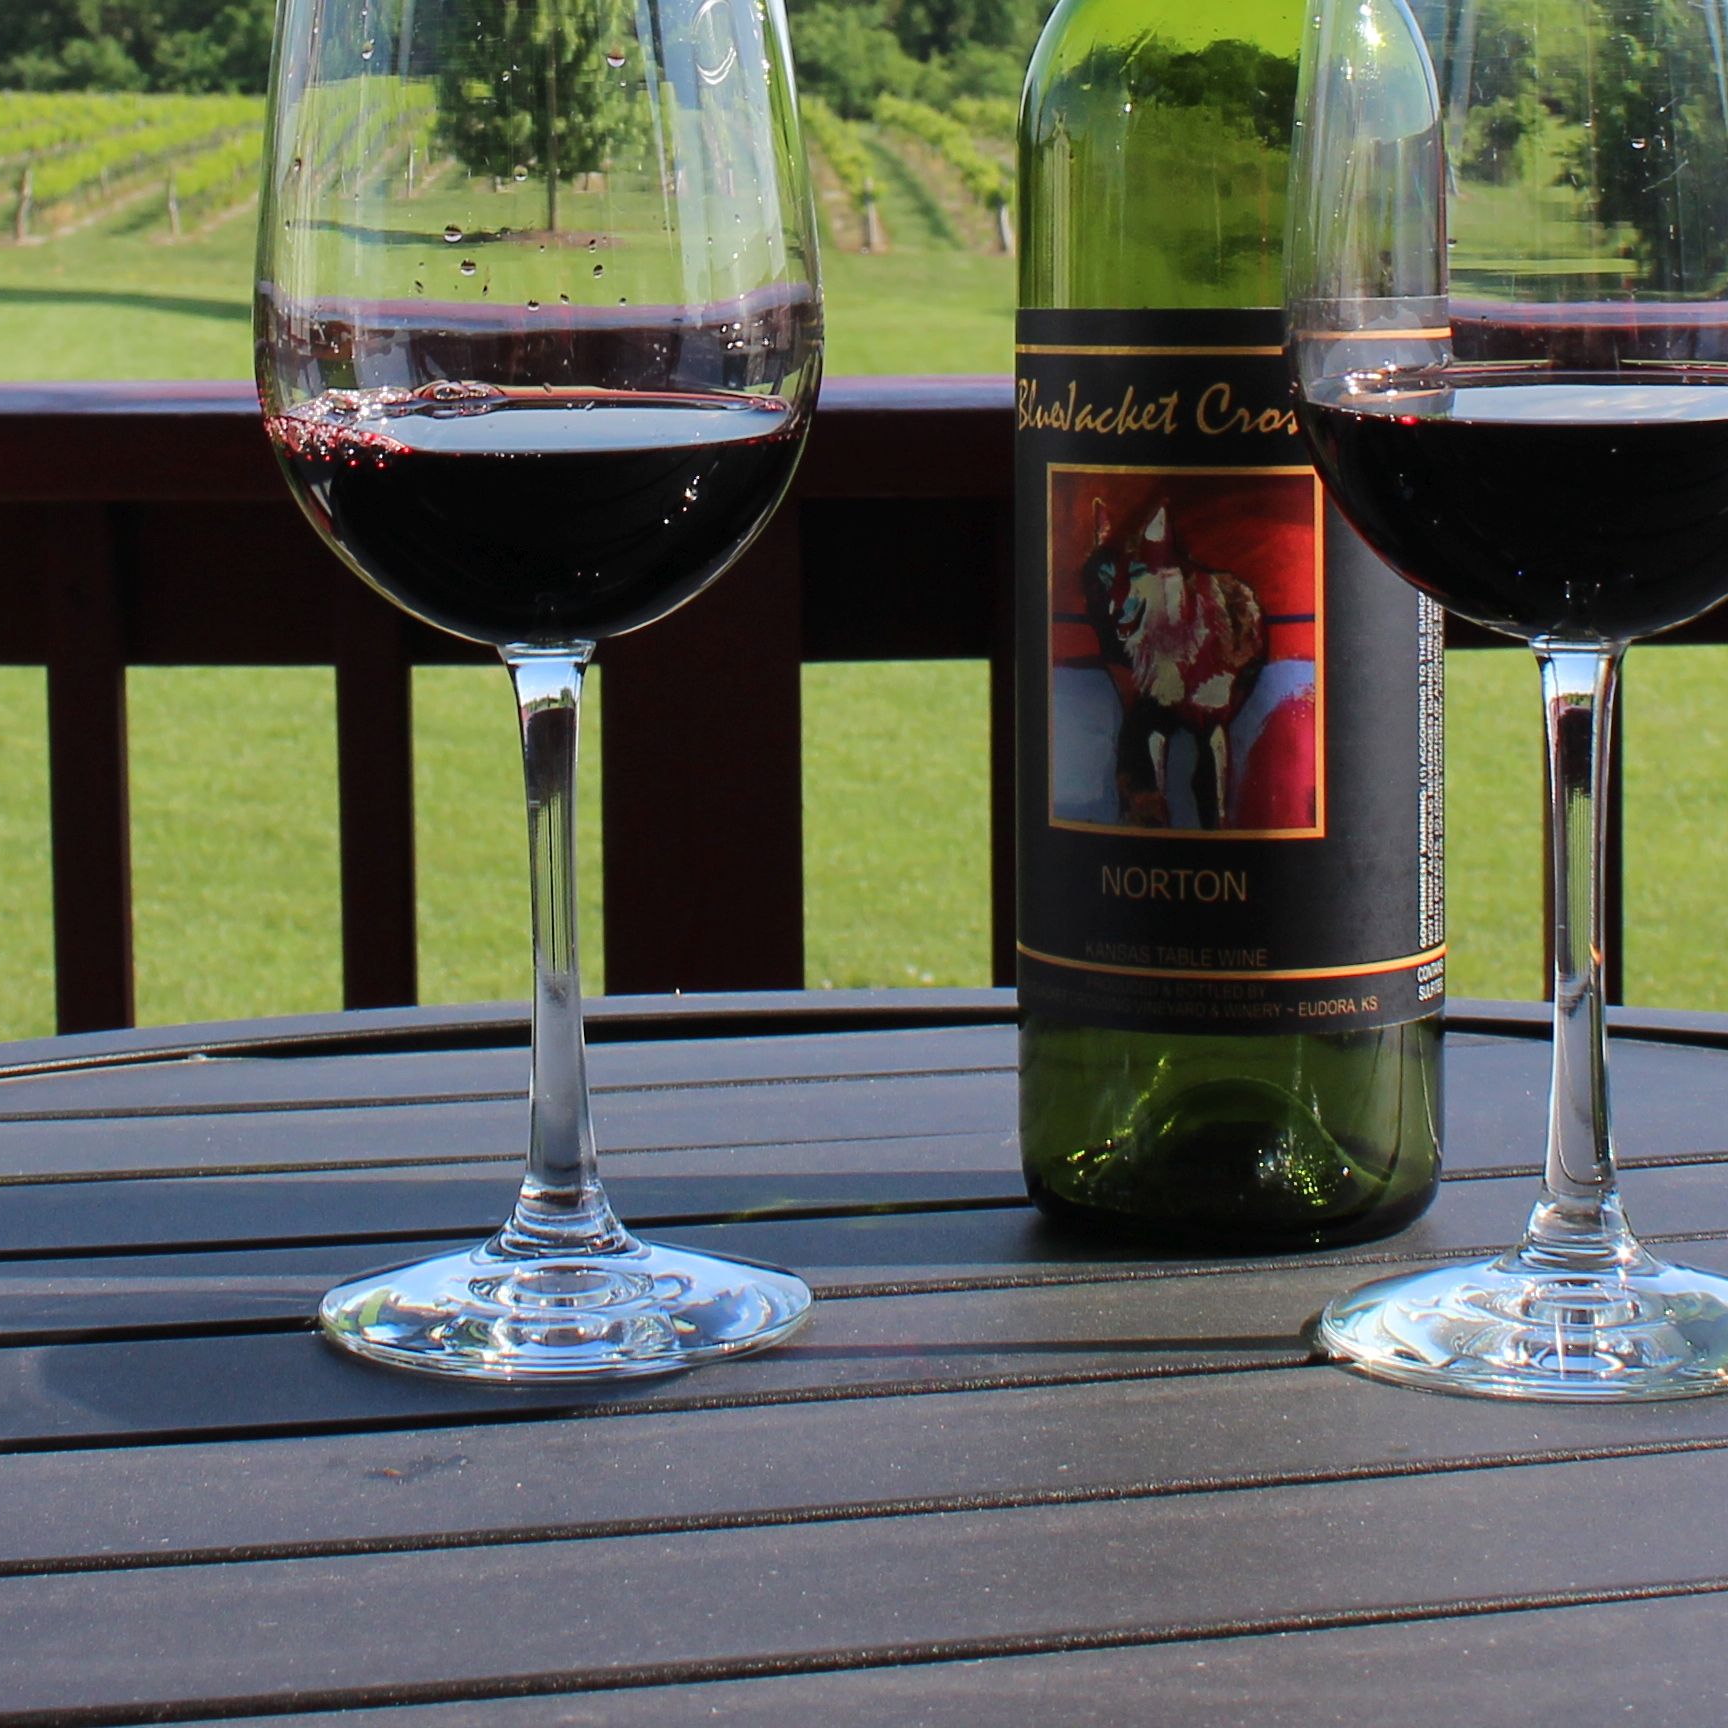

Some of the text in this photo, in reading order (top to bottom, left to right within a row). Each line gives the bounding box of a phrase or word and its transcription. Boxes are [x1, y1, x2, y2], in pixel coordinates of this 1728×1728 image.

[1419, 636, 1427, 662] THE
[1419, 664, 1427, 683] TO
[1419, 685, 1427, 765] ACCORDING
[1101, 864, 1248, 903] NORTON
[1419, 857, 1427, 949] GOVERNMENT
[1085, 941, 1269, 968] KANSAS TABLE WINE
[1175, 981, 1243, 1000] BOTTLED
[1247, 983, 1267, 999] BY
[1135, 1000, 1206, 1019] VINEYARD
[1225, 1001, 1281, 1019] WINERY
[1361, 995, 1379, 1013] KS
